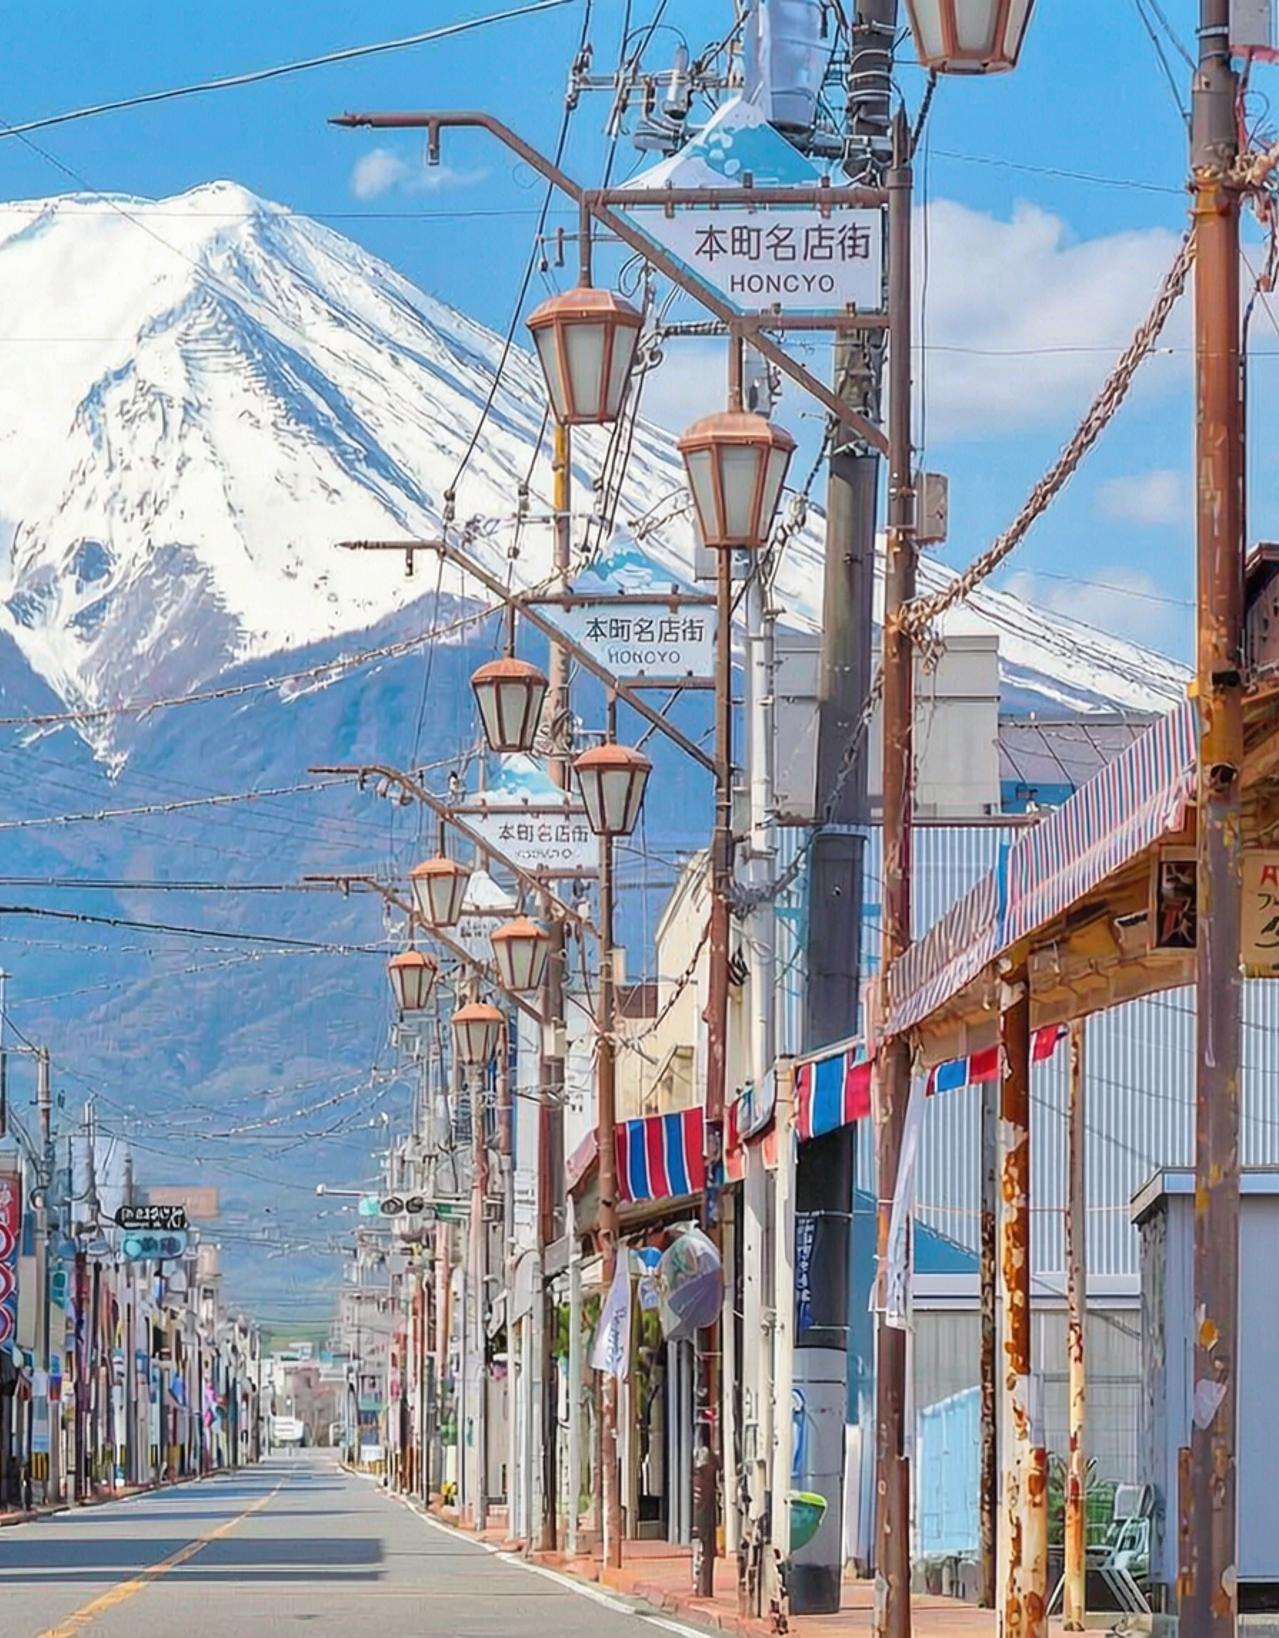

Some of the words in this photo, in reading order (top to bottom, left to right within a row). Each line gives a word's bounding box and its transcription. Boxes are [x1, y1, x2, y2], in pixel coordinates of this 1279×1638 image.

[695, 222, 871, 261] 本町名店街
[730, 274, 835, 293] HONCYO
[586, 617, 704, 643] 本町名店街
